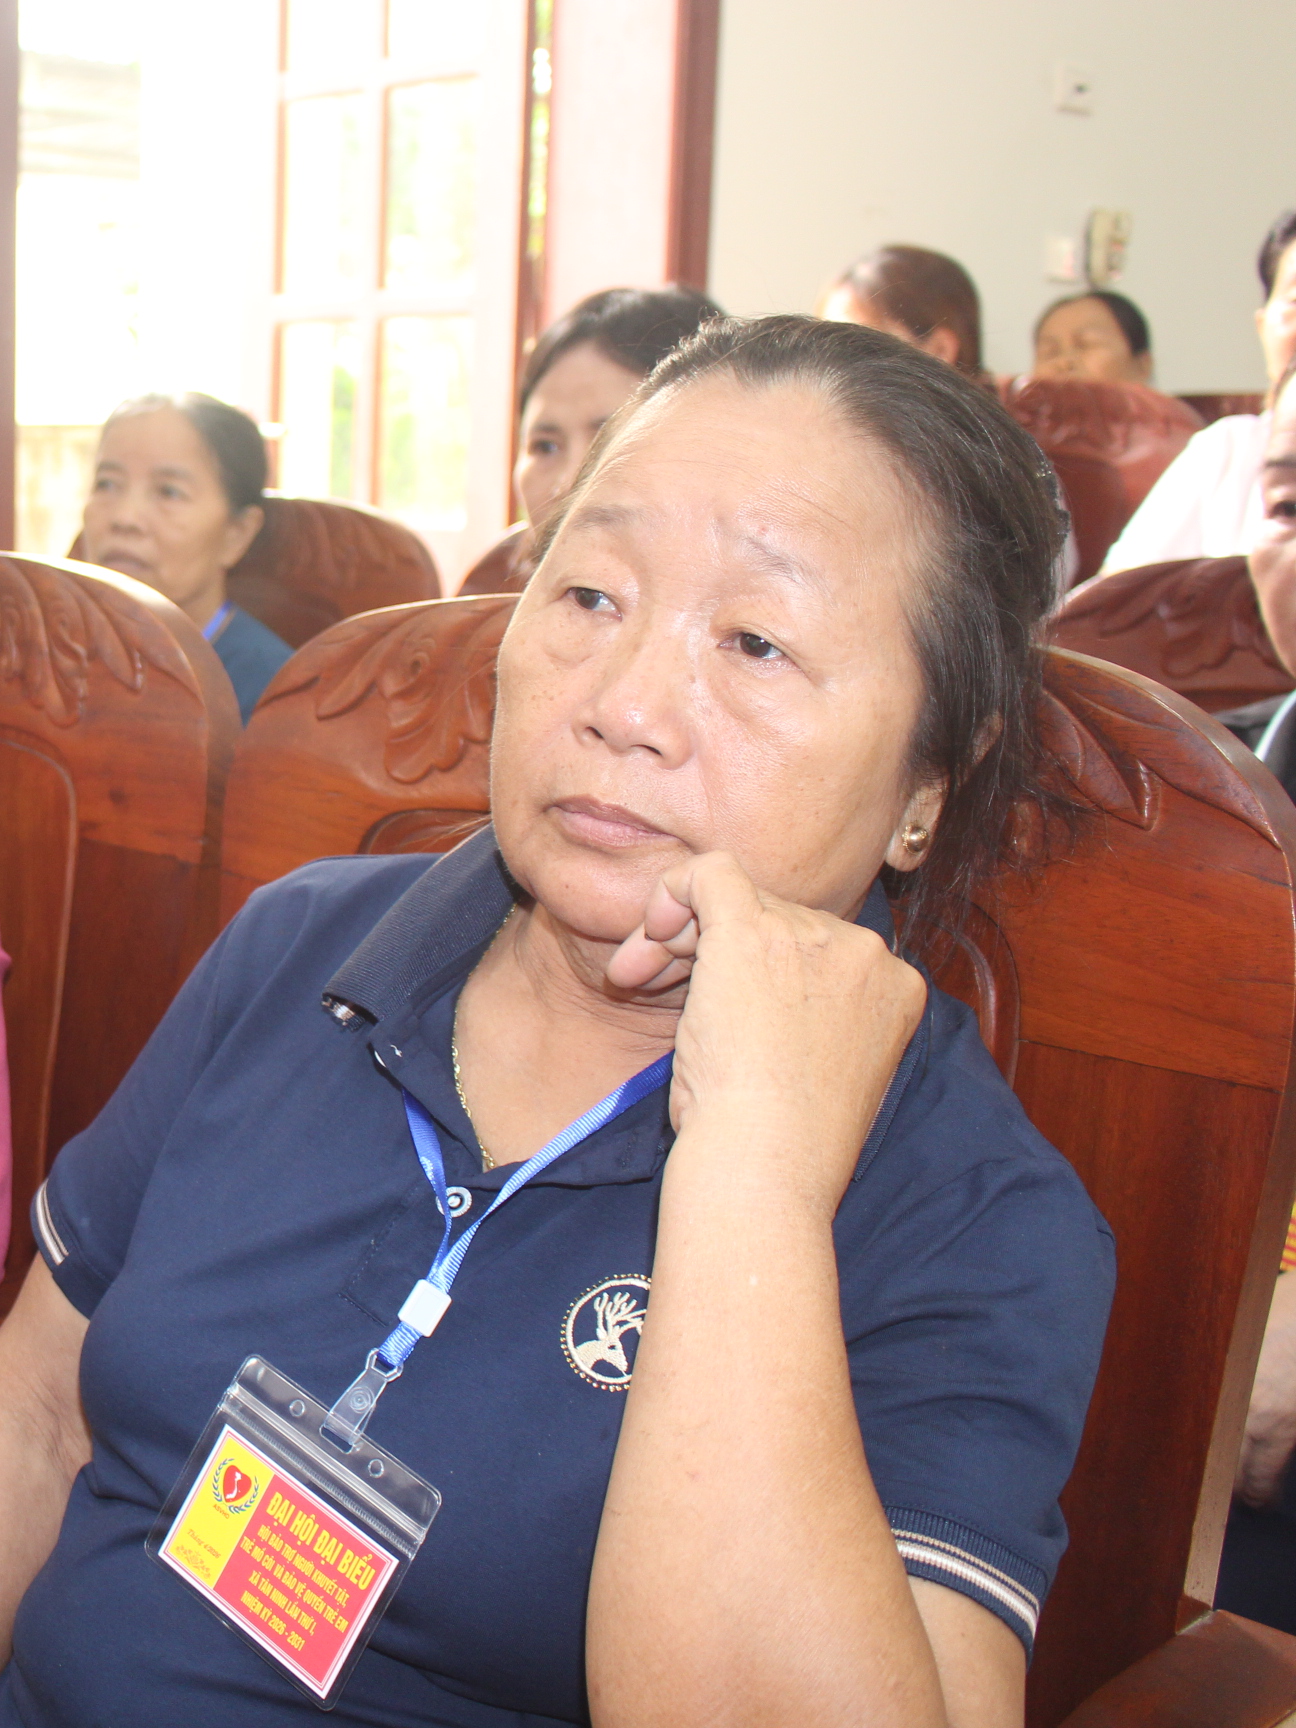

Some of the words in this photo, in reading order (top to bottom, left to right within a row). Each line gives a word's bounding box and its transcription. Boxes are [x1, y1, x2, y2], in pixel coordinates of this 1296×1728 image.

[257, 1524, 272, 1542] HỘI
[268, 1533, 284, 1552] BẢO
[281, 1543, 297, 1564] TRỢ
[292, 1553, 315, 1577] NGƯỜI
[311, 1569, 338, 1596] KHUYẾT
[266, 1491, 296, 1527] ĐẠI
[289, 1510, 320, 1546] HỘI
[313, 1529, 344, 1565] ĐẠI
[337, 1549, 376, 1590] BIỂU
[240, 1536, 256, 1554] TRẺ
[261, 1554, 276, 1571] CÔI
[273, 1564, 285, 1580] VÀ
[281, 1571, 297, 1590] BẢO
[294, 1581, 307, 1599] VỆ
[323, 1605, 340, 1624] TRẺ
[334, 1615, 349, 1633] EM
[240, 1590, 264, 1615] NHIỆM
[259, 1607, 272, 1622] KỲ
[268, 1615, 287, 1635] 2026
[287, 1631, 305, 1651] 2031
[248, 1570, 262, 1586] XÃ
[258, 1577, 274, 1596] TÂN
[269, 1588, 289, 1609] NINH
[297, 1611, 315, 1630] THỨ
